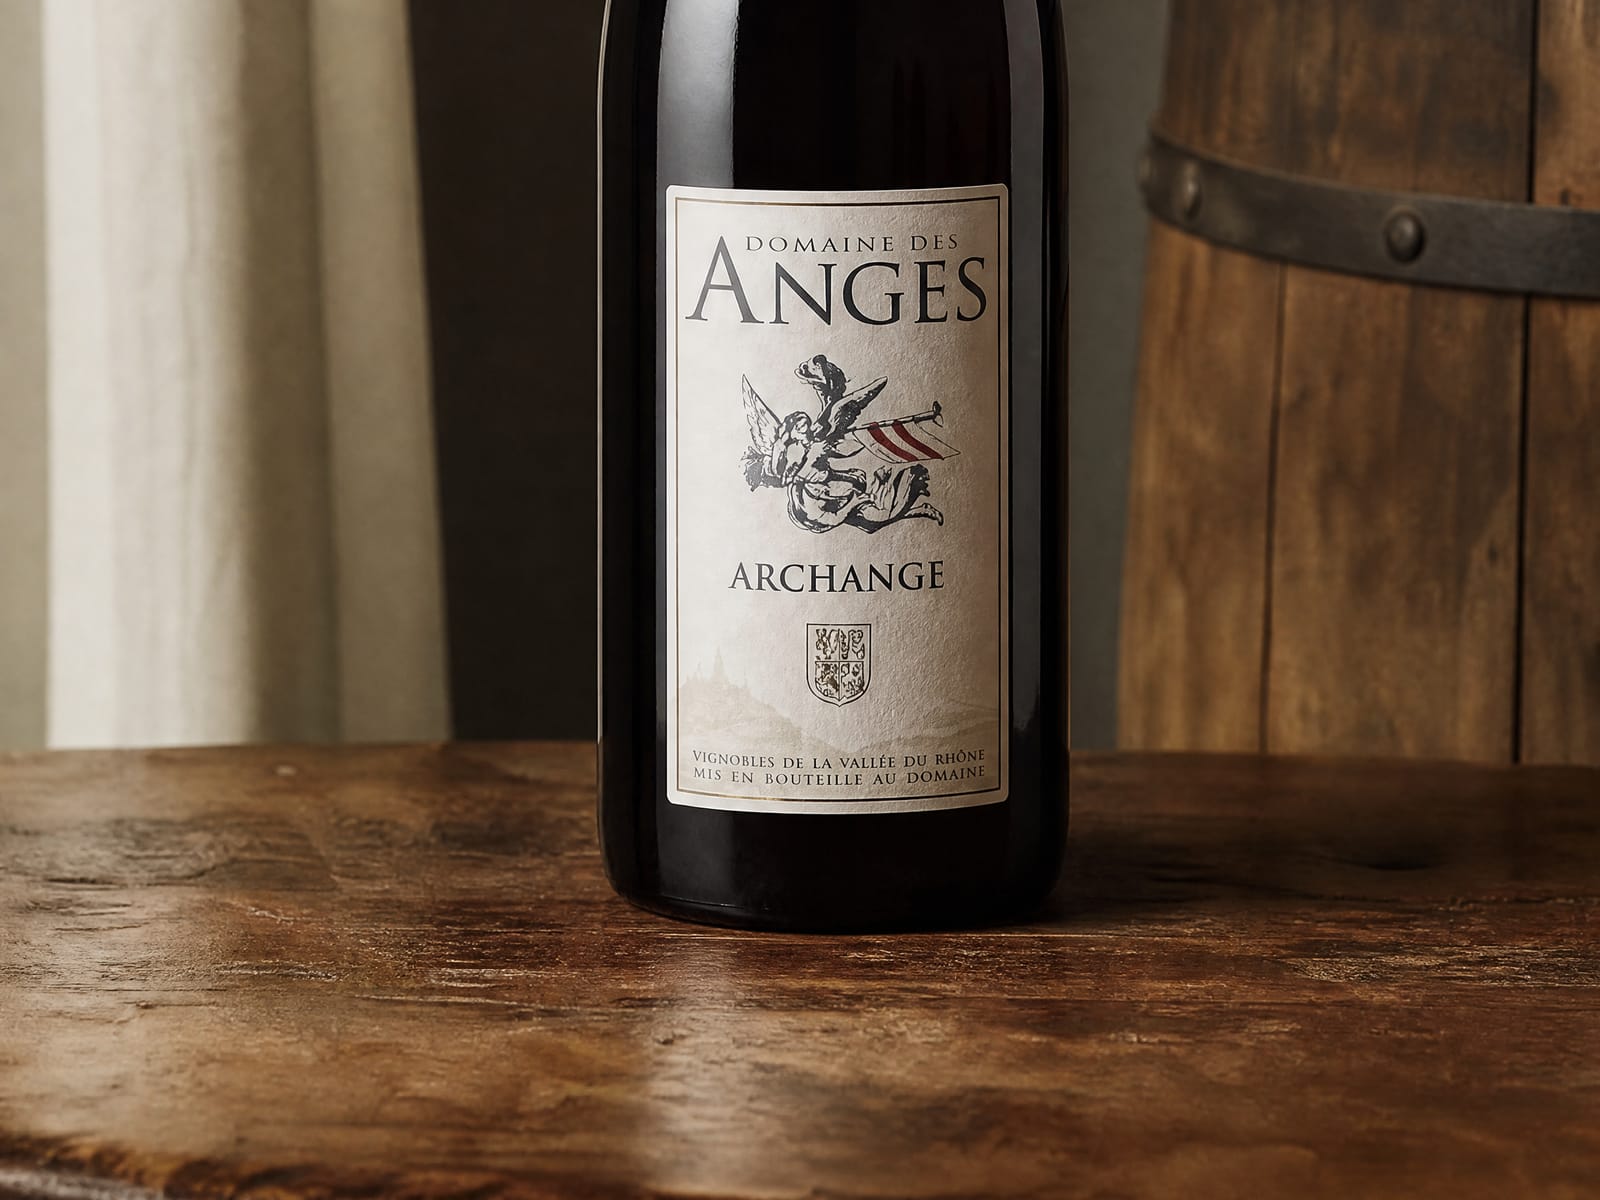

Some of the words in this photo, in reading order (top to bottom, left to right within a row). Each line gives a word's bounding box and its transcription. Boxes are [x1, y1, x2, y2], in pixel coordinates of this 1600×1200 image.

[745, 235, 894, 252] DOMAINE
[910, 234, 958, 250] DES
[685, 235, 987, 326] ANGES
[728, 560, 945, 593] ARCHANGE
[692, 750, 775, 768] VIGNOBLES
[783, 757, 803, 769] DE
[813, 758, 832, 769] LA
[840, 754, 896, 769] VALLÉE
[904, 755, 927, 768] DU
[935, 749, 985, 765] RHÔNE
[693, 767, 721, 780] MIS
[732, 771, 754, 783] EN
[765, 773, 863, 786] BOUTEILLE
[873, 773, 896, 785] AU
[907, 765, 985, 784] DOMAINE
